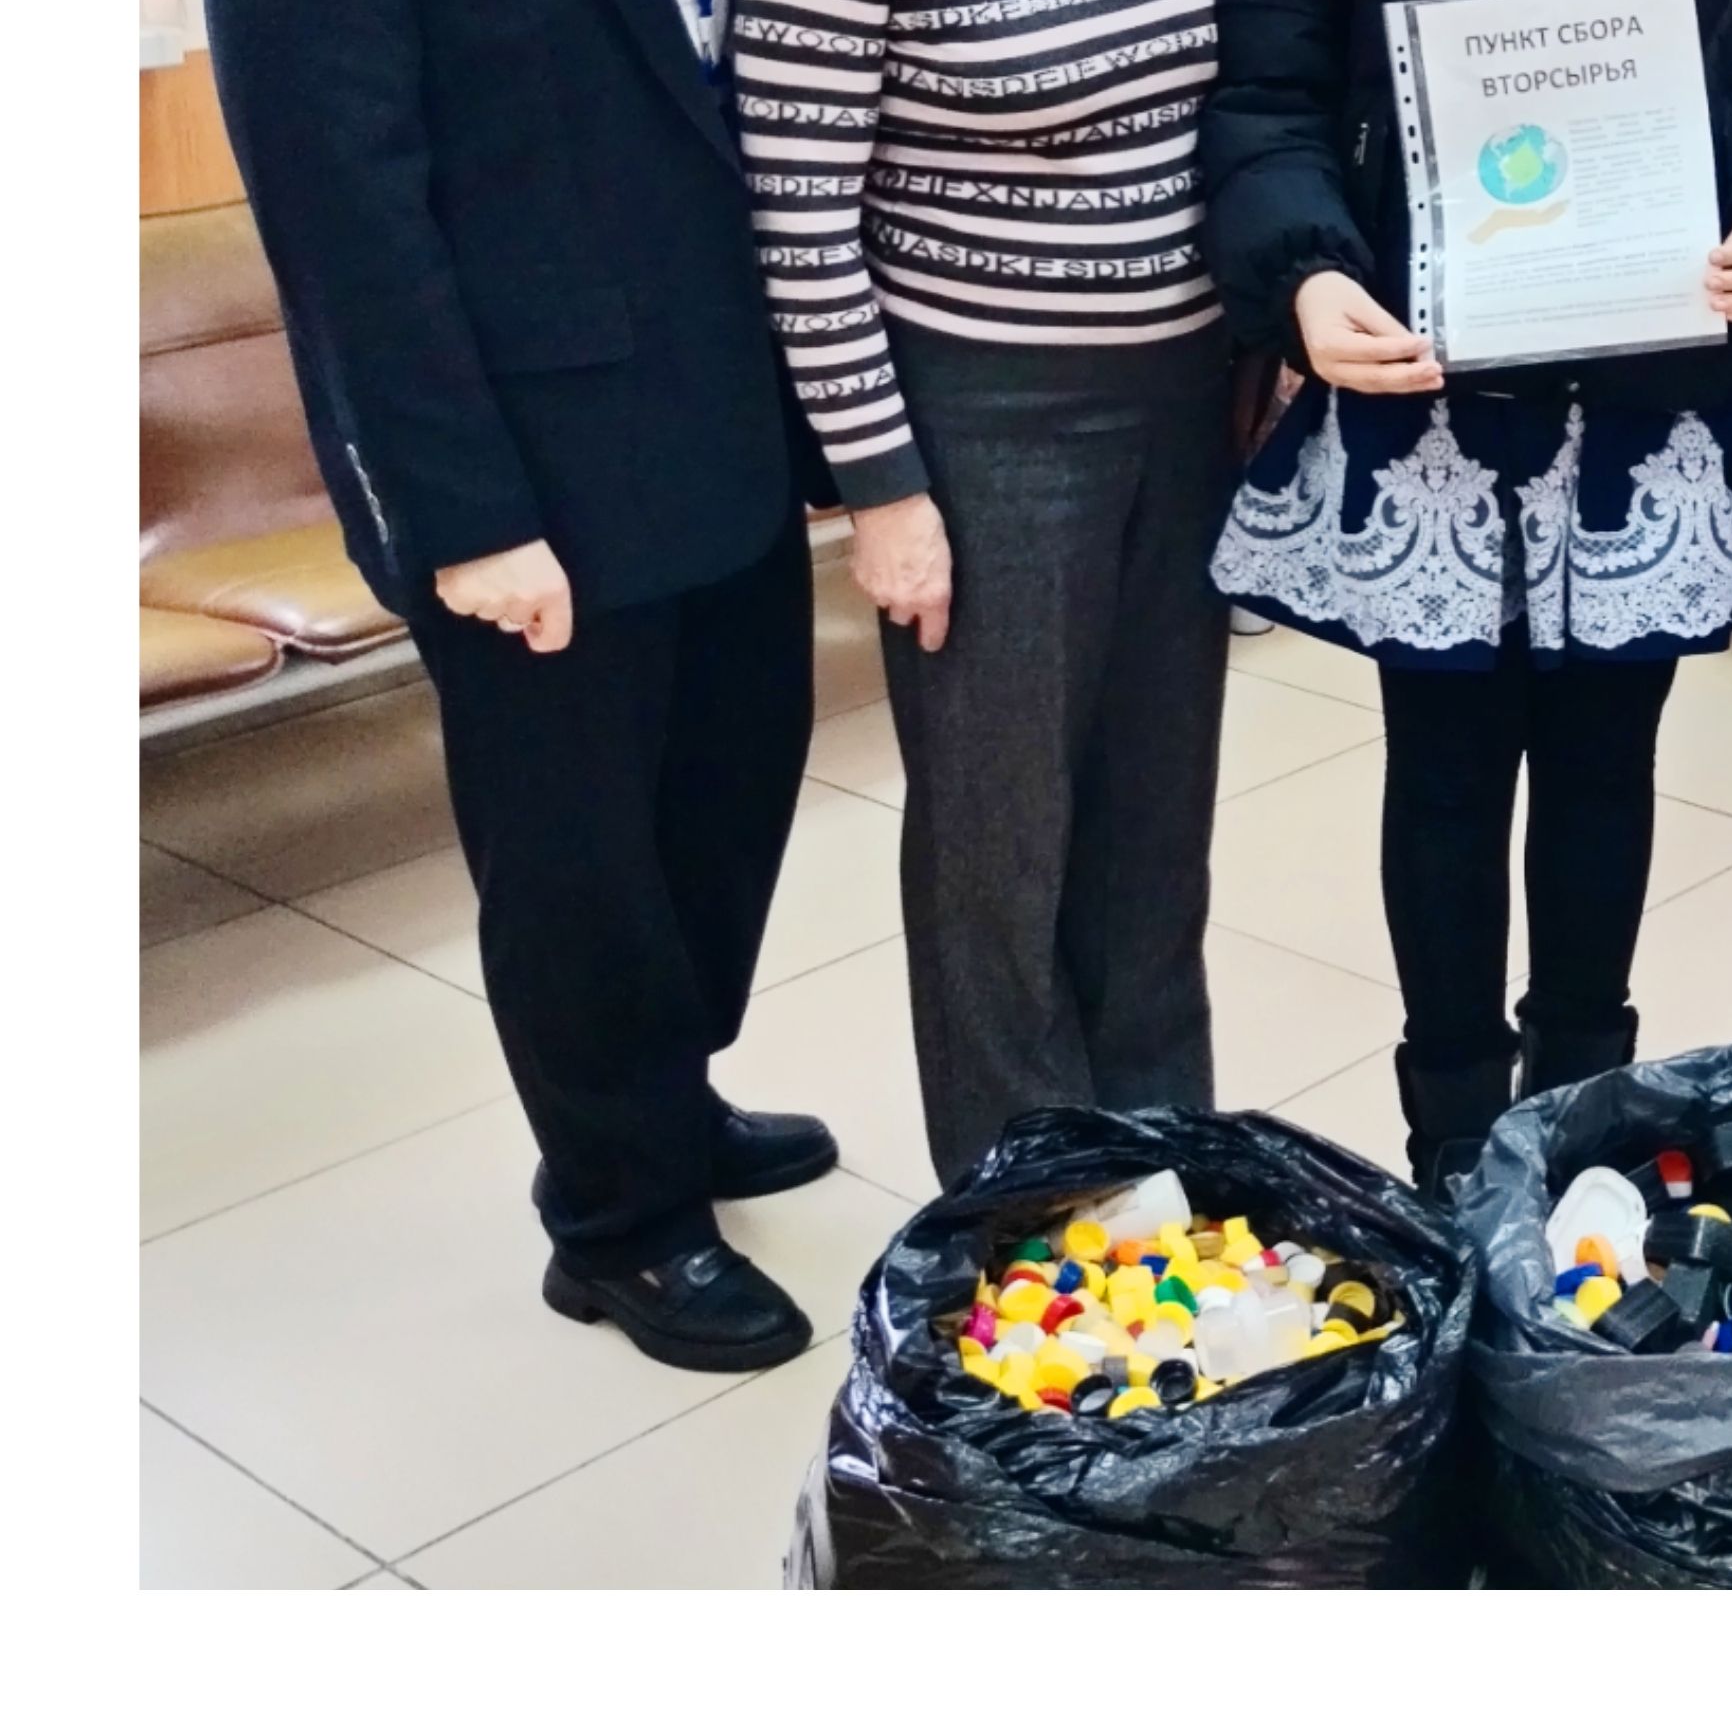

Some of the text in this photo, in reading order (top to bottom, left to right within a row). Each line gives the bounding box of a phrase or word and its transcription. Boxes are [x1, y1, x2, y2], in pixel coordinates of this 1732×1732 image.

[1464, 14, 1645, 56] ПУНКТ СБОРА
[1481, 58, 1638, 98] ВТОРСЫРЬЯ
